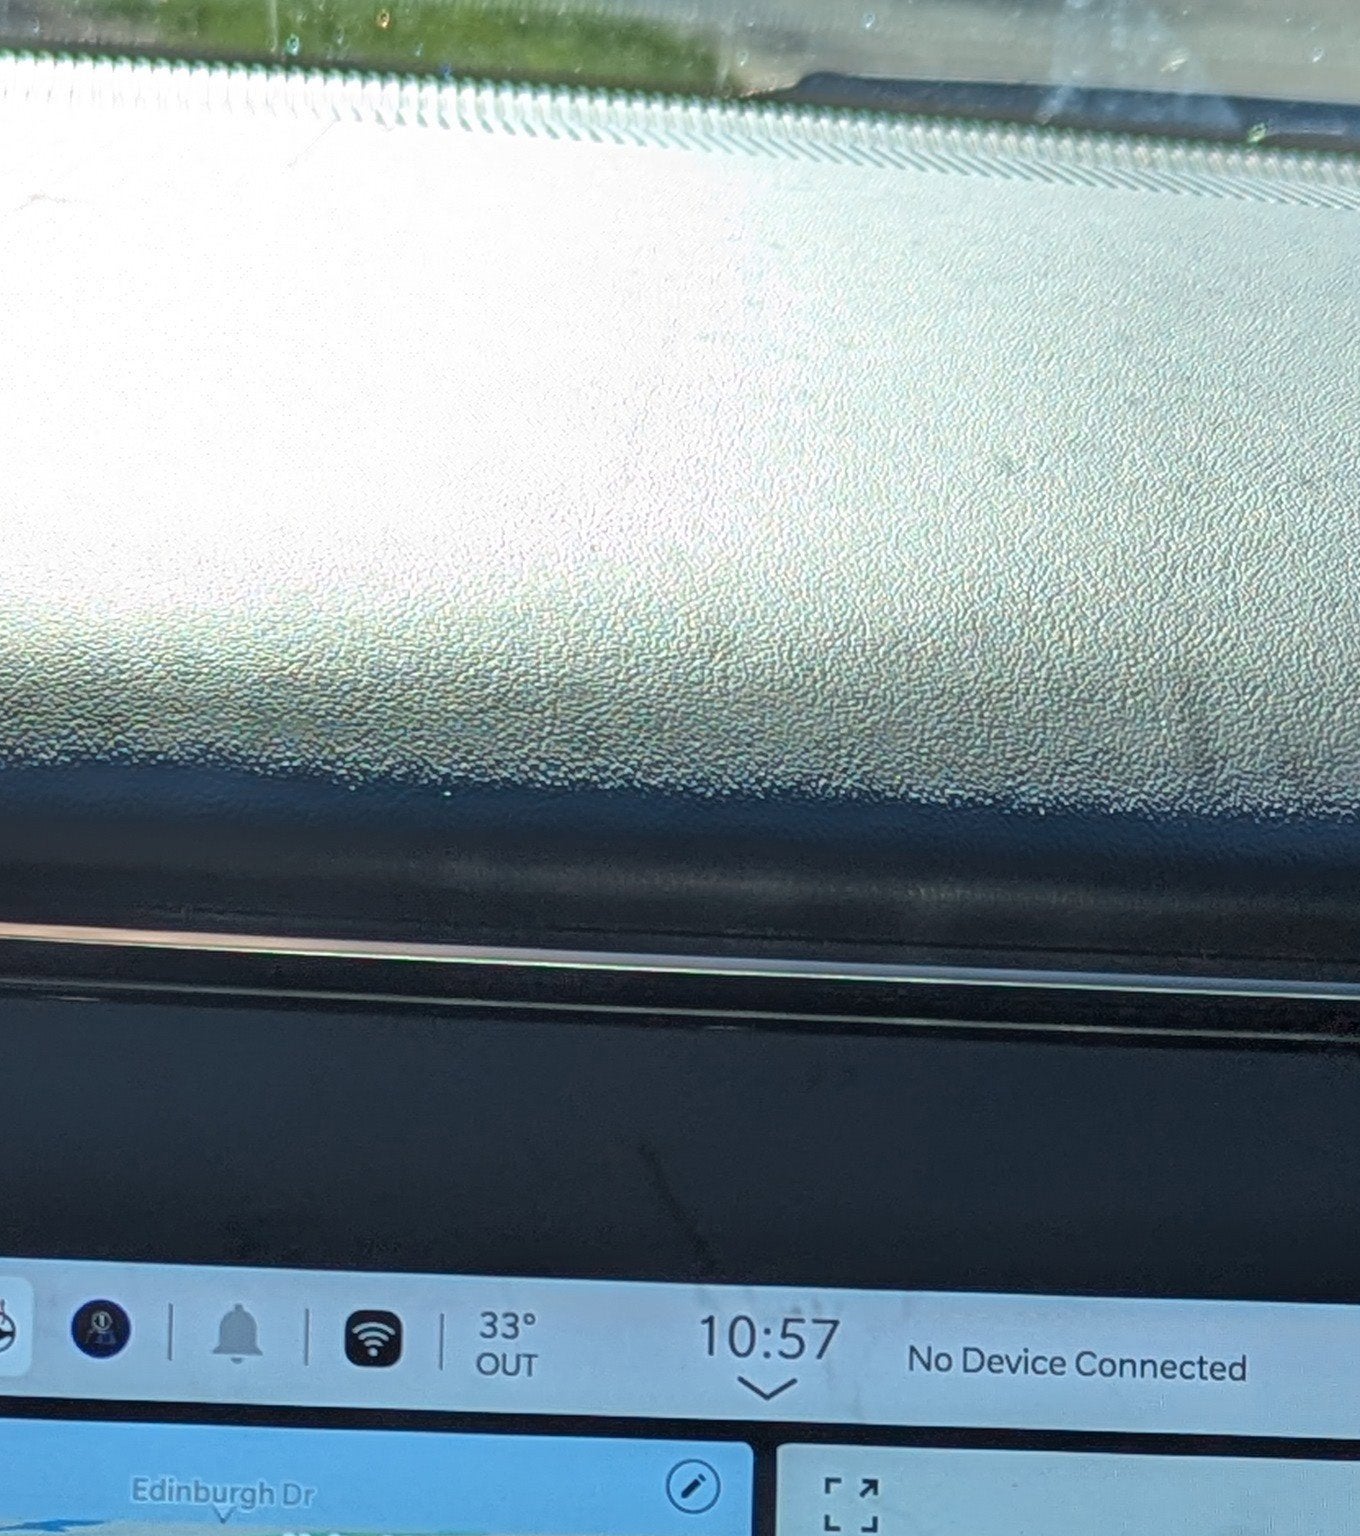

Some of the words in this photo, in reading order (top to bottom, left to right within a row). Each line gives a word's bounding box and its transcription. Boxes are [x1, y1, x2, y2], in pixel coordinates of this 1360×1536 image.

[701, 1314, 841, 1361] 10:57
[477, 1353, 538, 1378] OUT
[908, 1345, 953, 1373] No
[963, 1347, 1066, 1376] Device
[1075, 1350, 1248, 1382] Connected
[133, 1477, 273, 1508] Edinburgh
[283, 1483, 314, 1507] Dr
